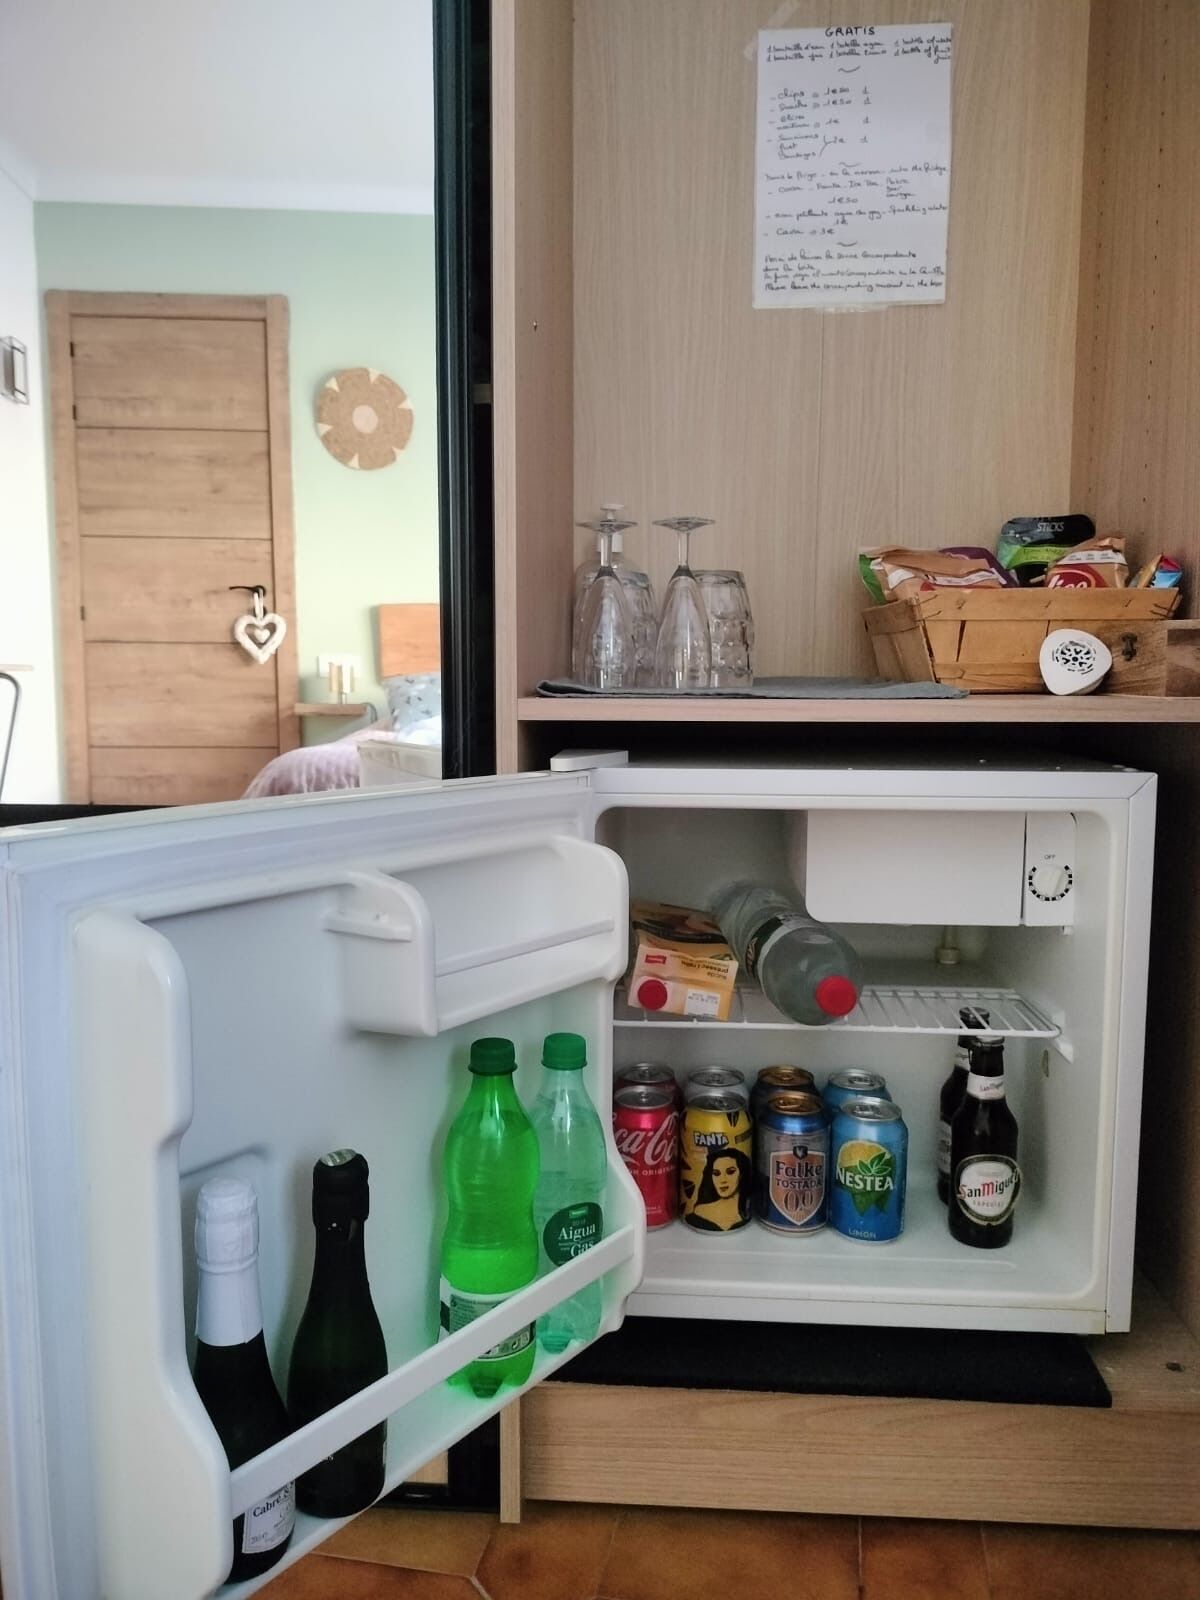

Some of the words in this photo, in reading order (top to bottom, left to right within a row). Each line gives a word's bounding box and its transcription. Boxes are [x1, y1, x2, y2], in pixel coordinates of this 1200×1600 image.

[825, 26, 875, 37] GRATIS
[693, 1131, 729, 1146] FANTA
[775, 1159, 823, 1178] Falke
[775, 1178, 823, 1190] TOSTADA
[835, 1165, 894, 1192] NESTEA
[558, 1223, 596, 1242] Aigua
